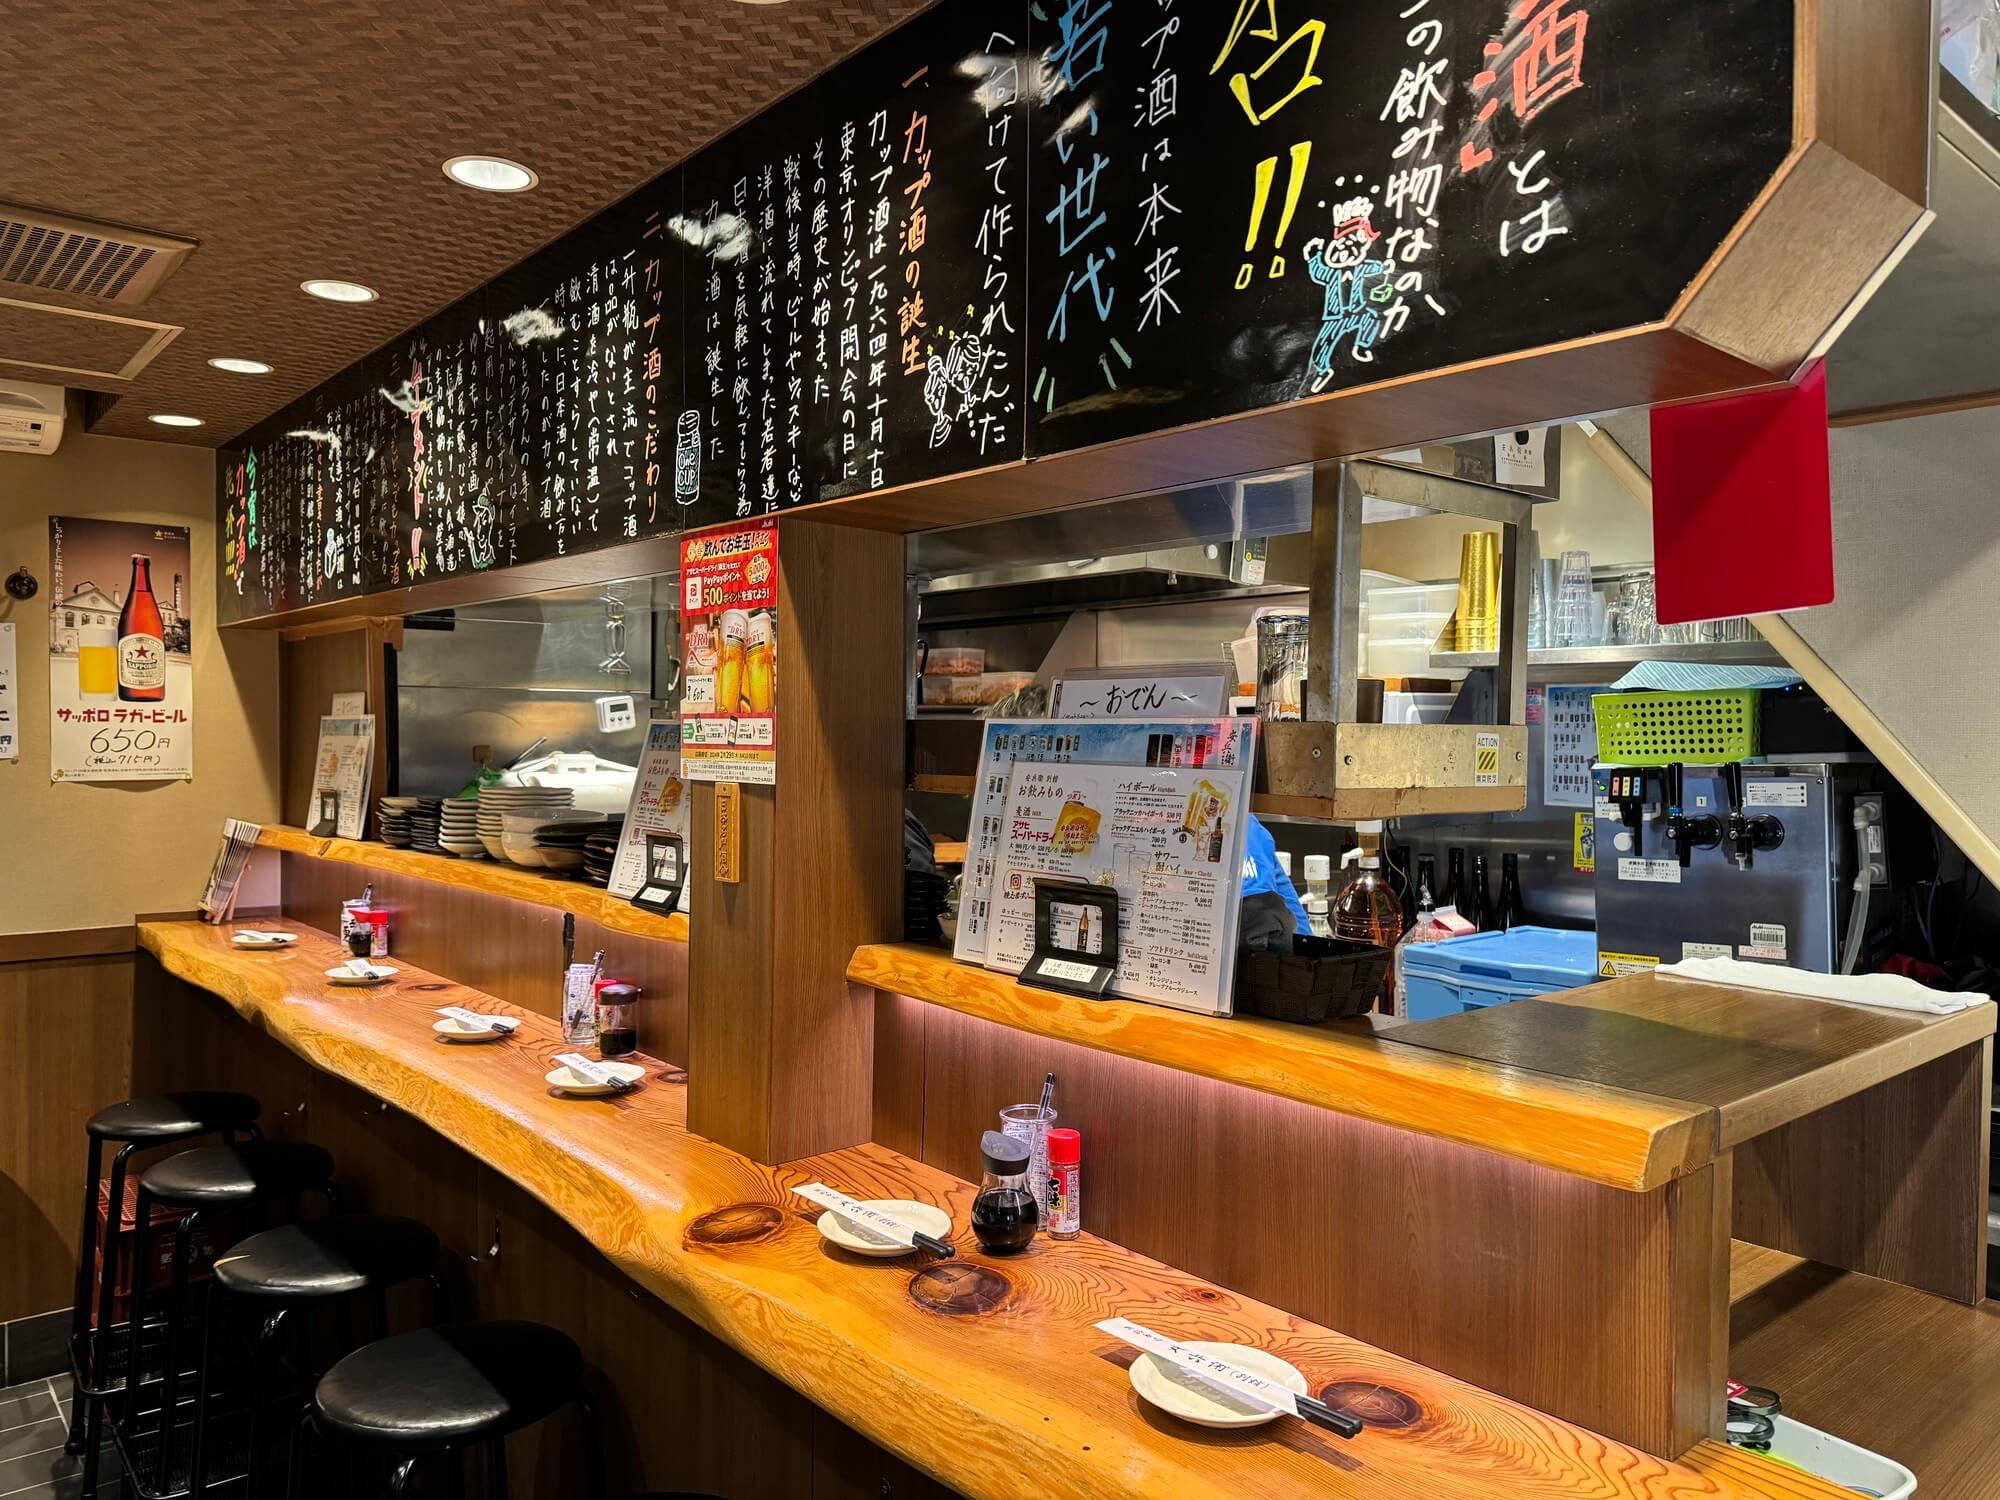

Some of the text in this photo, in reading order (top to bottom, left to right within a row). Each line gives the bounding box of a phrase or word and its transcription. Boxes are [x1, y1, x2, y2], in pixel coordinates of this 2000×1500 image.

[1134, 0, 1182, 332] プ酒は本来
[1379, 0, 1447, 338] の飲み物なのか
[811, 137, 833, 404] その歴史が始まった
[839, 121, 861, 479] 東京オリンピック開会の日に
[867, 110, 894, 488] カップ酒は一九六四年十月十日
[704, 199, 725, 461] カプ酒は誕生した
[679, 452, 695, 469] One
[678, 469, 695, 487] CUP
[89, 727, 171, 753] 650円
[1476, 736, 1499, 748] ACTION
[1018, 785, 1063, 798] お飲みもの
[1117, 782, 1157, 792] ハイボール
[1010, 830, 1056, 843] スーパードライ
[1154, 851, 1179, 861] サワー
[1149, 944, 1184, 956] ソフトドリンク
